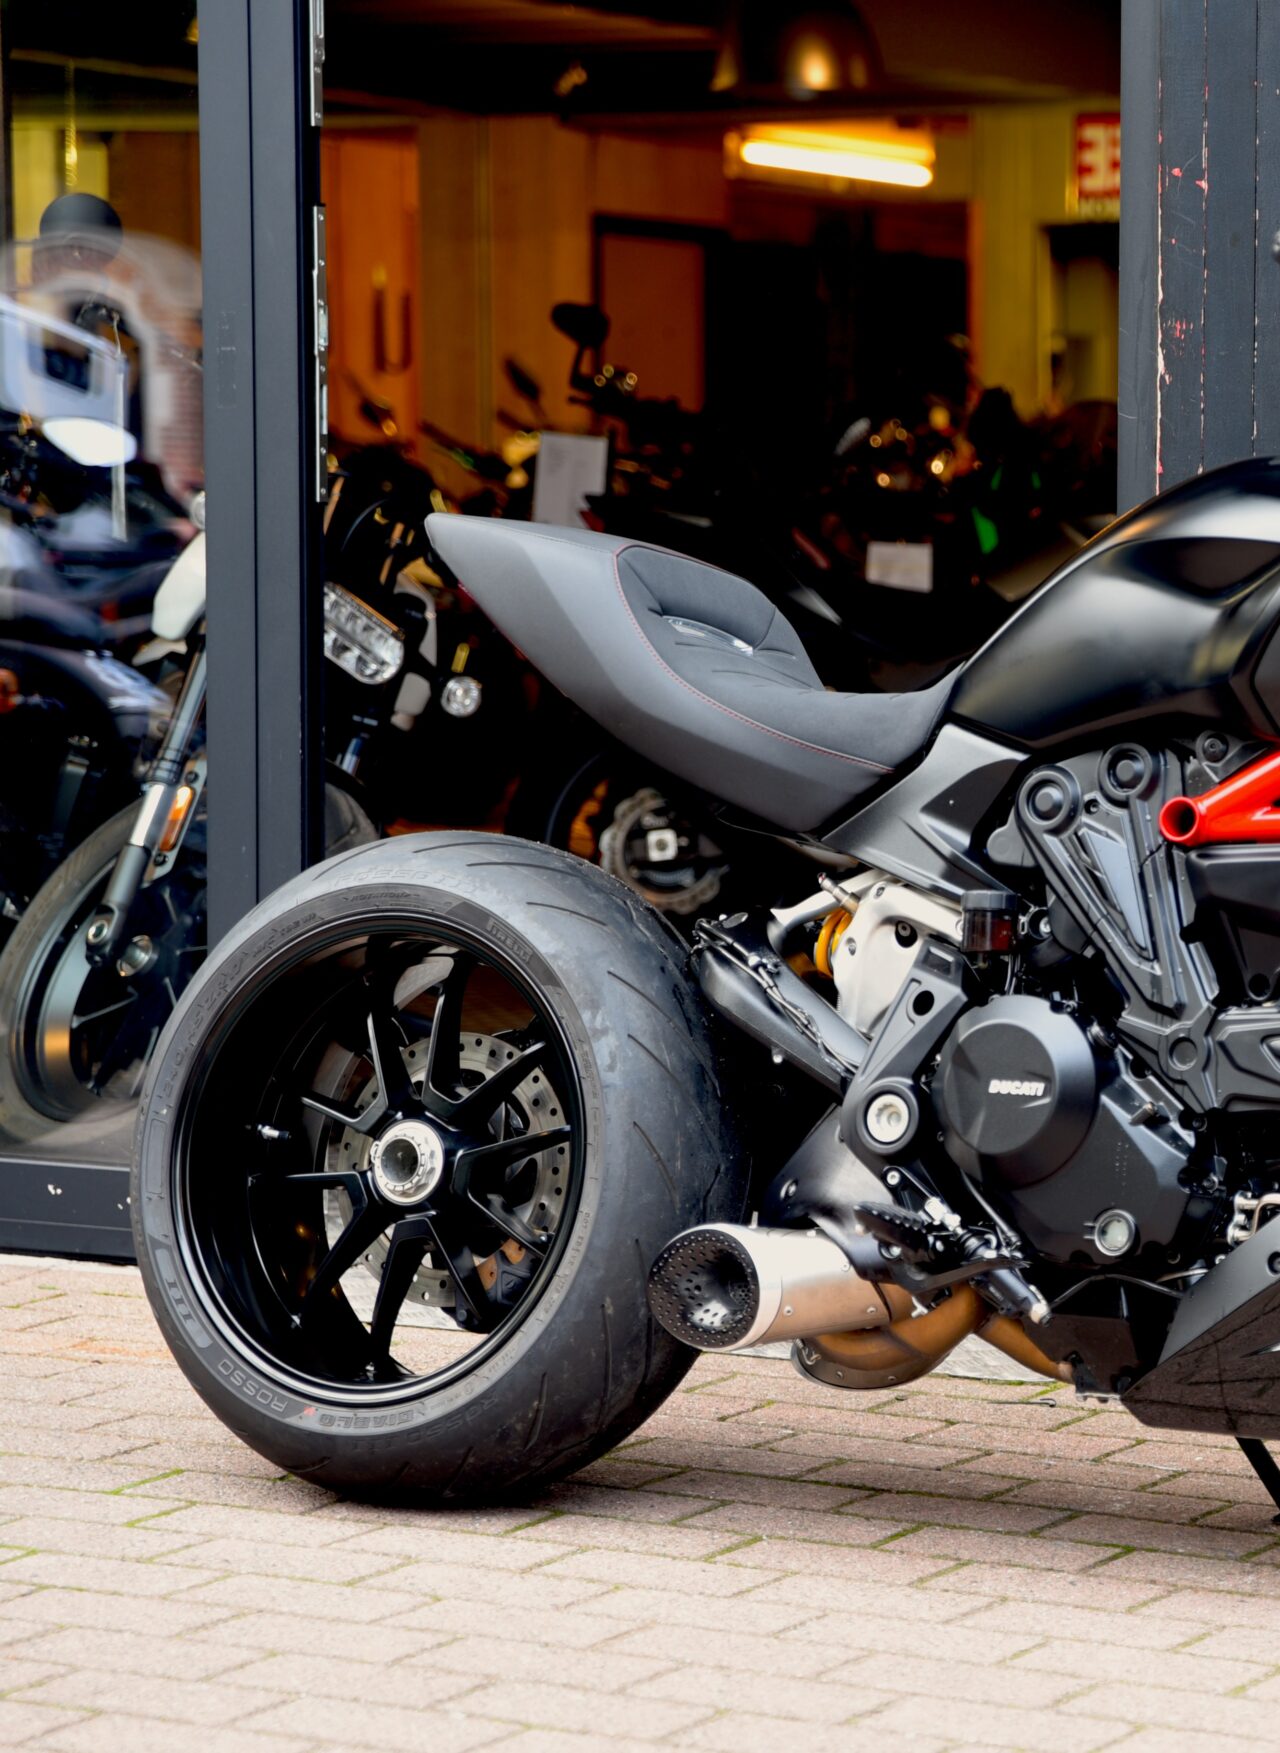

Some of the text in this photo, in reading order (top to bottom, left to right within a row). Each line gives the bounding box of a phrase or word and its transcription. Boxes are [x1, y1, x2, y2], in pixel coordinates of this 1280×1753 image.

[484, 917, 534, 964] PIRELLI
[988, 1079, 1045, 1097] DUCATI
[217, 1357, 289, 1414] ROSSO
[318, 1408, 415, 1429] DIABLO
